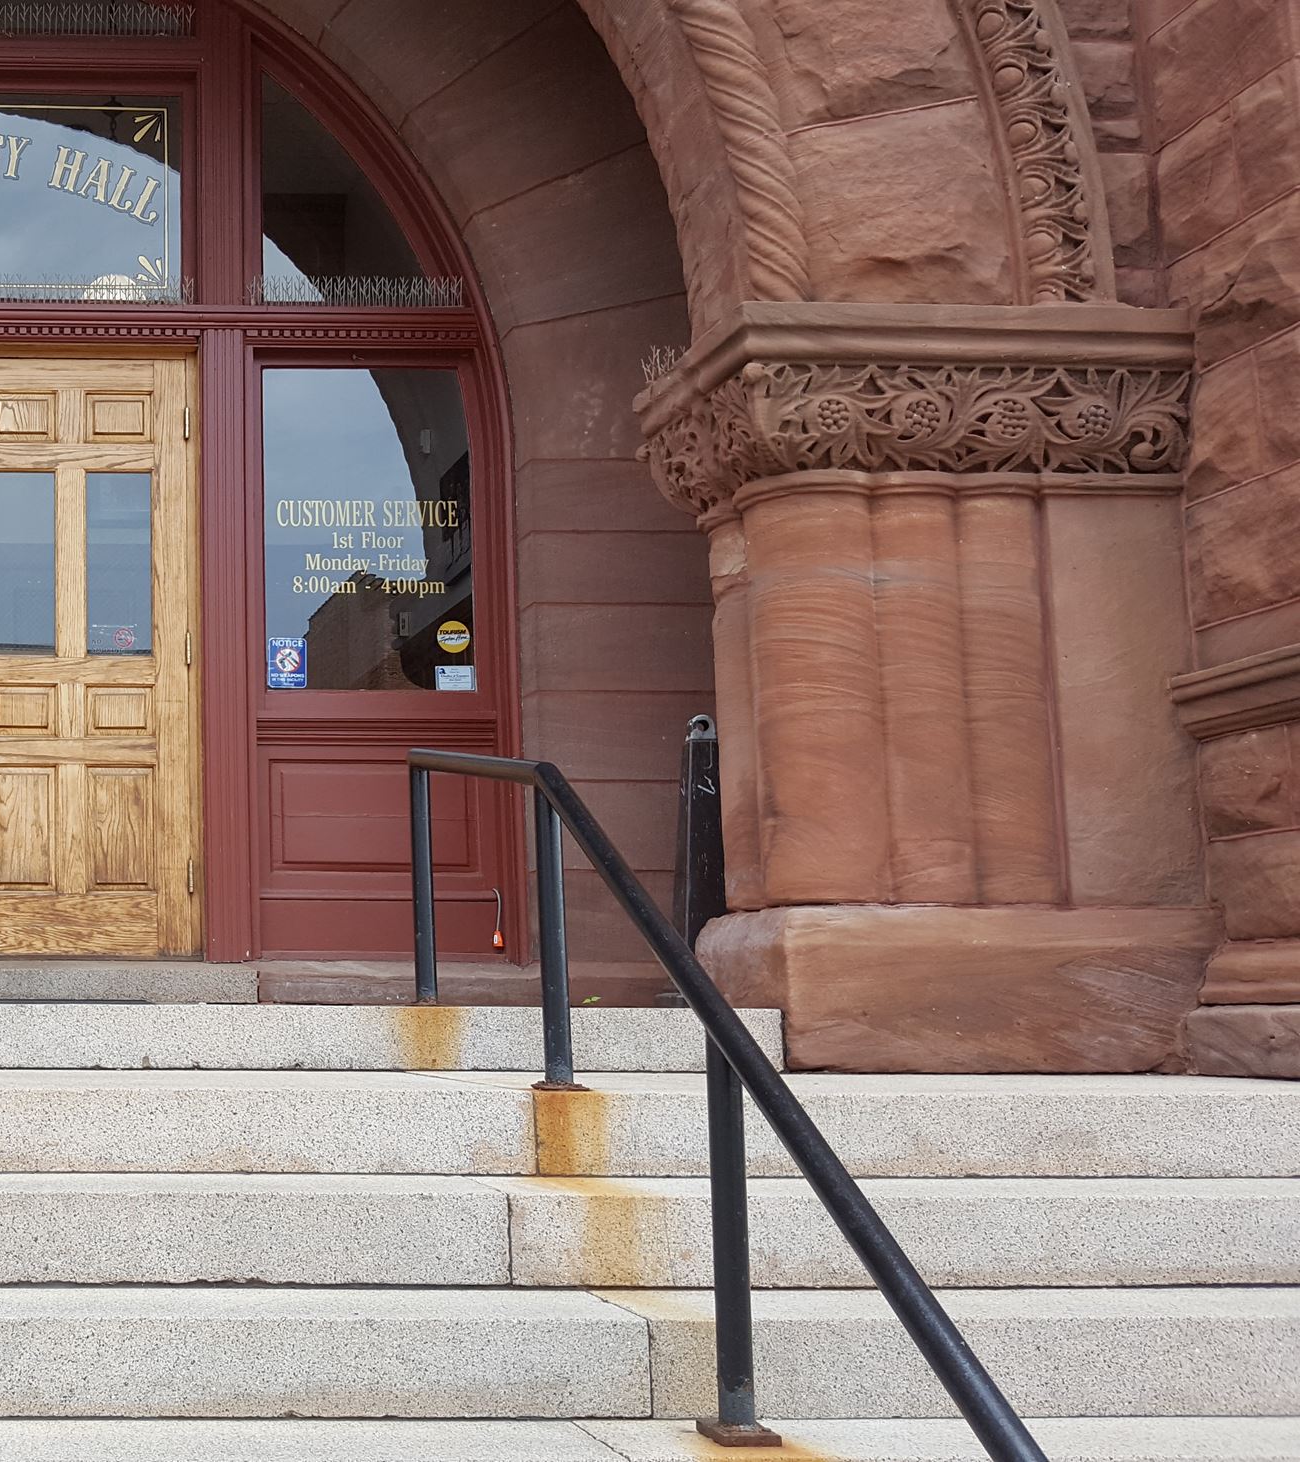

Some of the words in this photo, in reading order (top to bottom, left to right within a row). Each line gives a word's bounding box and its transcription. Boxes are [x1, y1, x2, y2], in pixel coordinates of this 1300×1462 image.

[48, 144, 163, 227] HALL
[276, 499, 376, 527] CUSTOMER
[383, 500, 459, 527] SERVICE
[331, 531, 354, 549] 1st
[361, 531, 404, 549] Floor
[305, 553, 430, 575] Monday-Friday
[292, 575, 357, 594] 8:00am
[381, 576, 445, 599] 4:00pm
[272, 639, 304, 647] NOTICE
